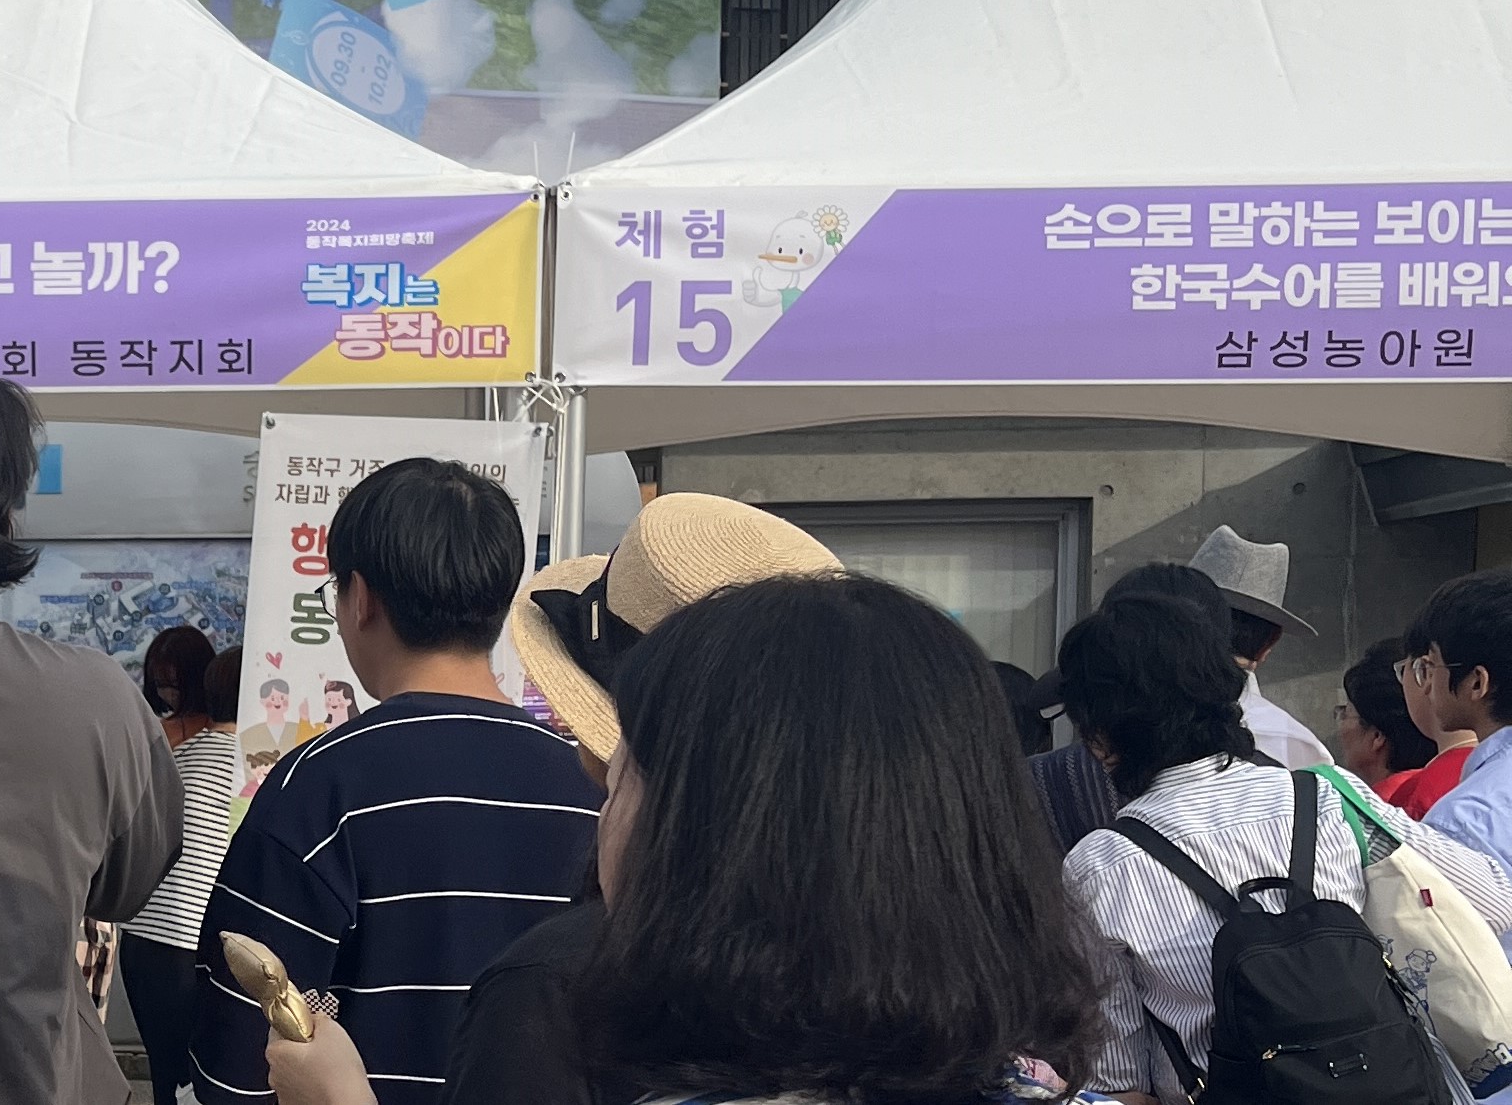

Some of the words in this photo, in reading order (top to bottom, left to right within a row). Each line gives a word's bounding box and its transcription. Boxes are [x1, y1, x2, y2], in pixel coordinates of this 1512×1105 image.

[329, 31, 357, 87] 09.30
[367, 53, 393, 105] 10.02
[305, 219, 351, 232] 2024
[1043, 200, 1195, 250] 손으로
[1207, 200, 1360, 247] 말하는
[29, 239, 182, 294] 놀까?
[300, 261, 440, 309] 복지는
[1129, 261, 1385, 310] 한국수어를
[1398, 260, 1512, 308] 배워
[334, 310, 511, 361] 동작이다
[615, 277, 733, 368] 15
[69, 336, 255, 377] 동작지회
[1214, 328, 1474, 369] 삼성농아원
[286, 455, 341, 478] 동작구
[274, 482, 331, 505] 자립과
